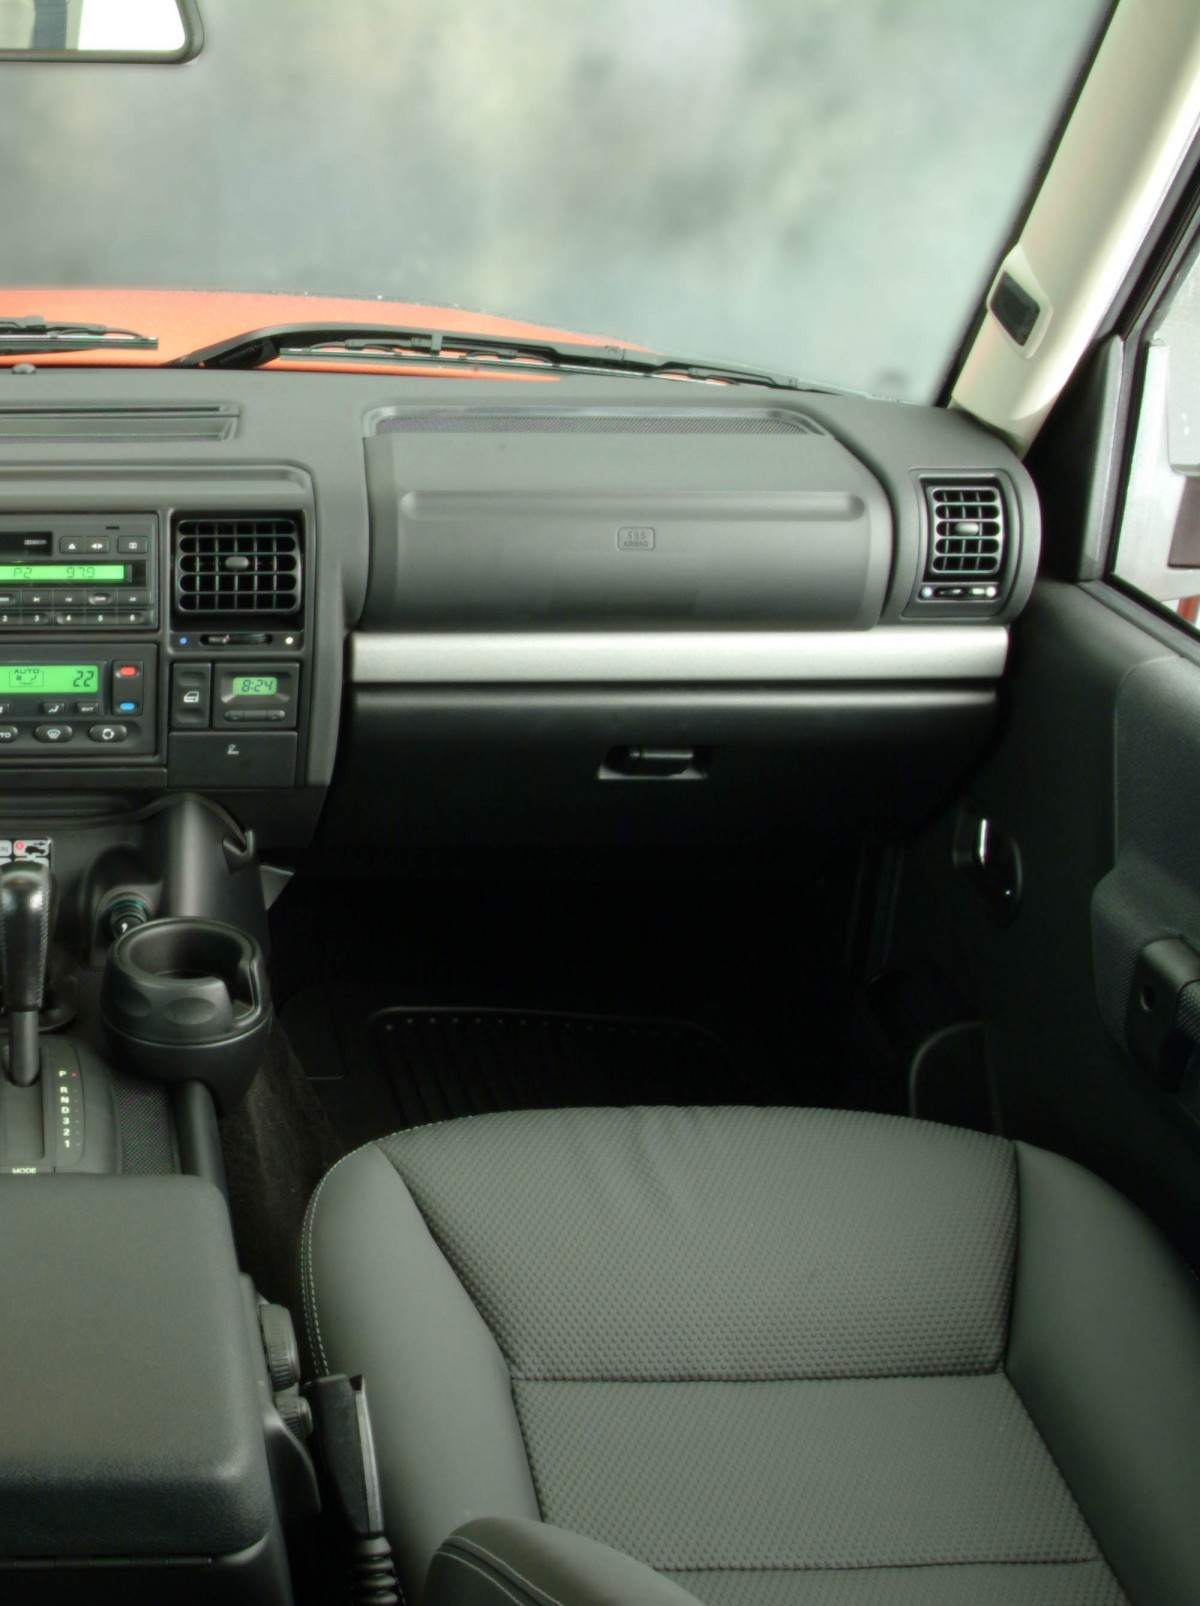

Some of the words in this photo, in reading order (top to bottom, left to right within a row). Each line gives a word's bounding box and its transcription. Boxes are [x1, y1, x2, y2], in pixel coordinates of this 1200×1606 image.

[13, 567, 32, 579] P2
[72, 670, 95, 687] 22
[241, 679, 274, 692] 8:24
[61, 1106, 70, 1114] D
[63, 1117, 70, 1125] 3
[63, 1128, 70, 1136] 2
[65, 1140, 70, 1148] 1
